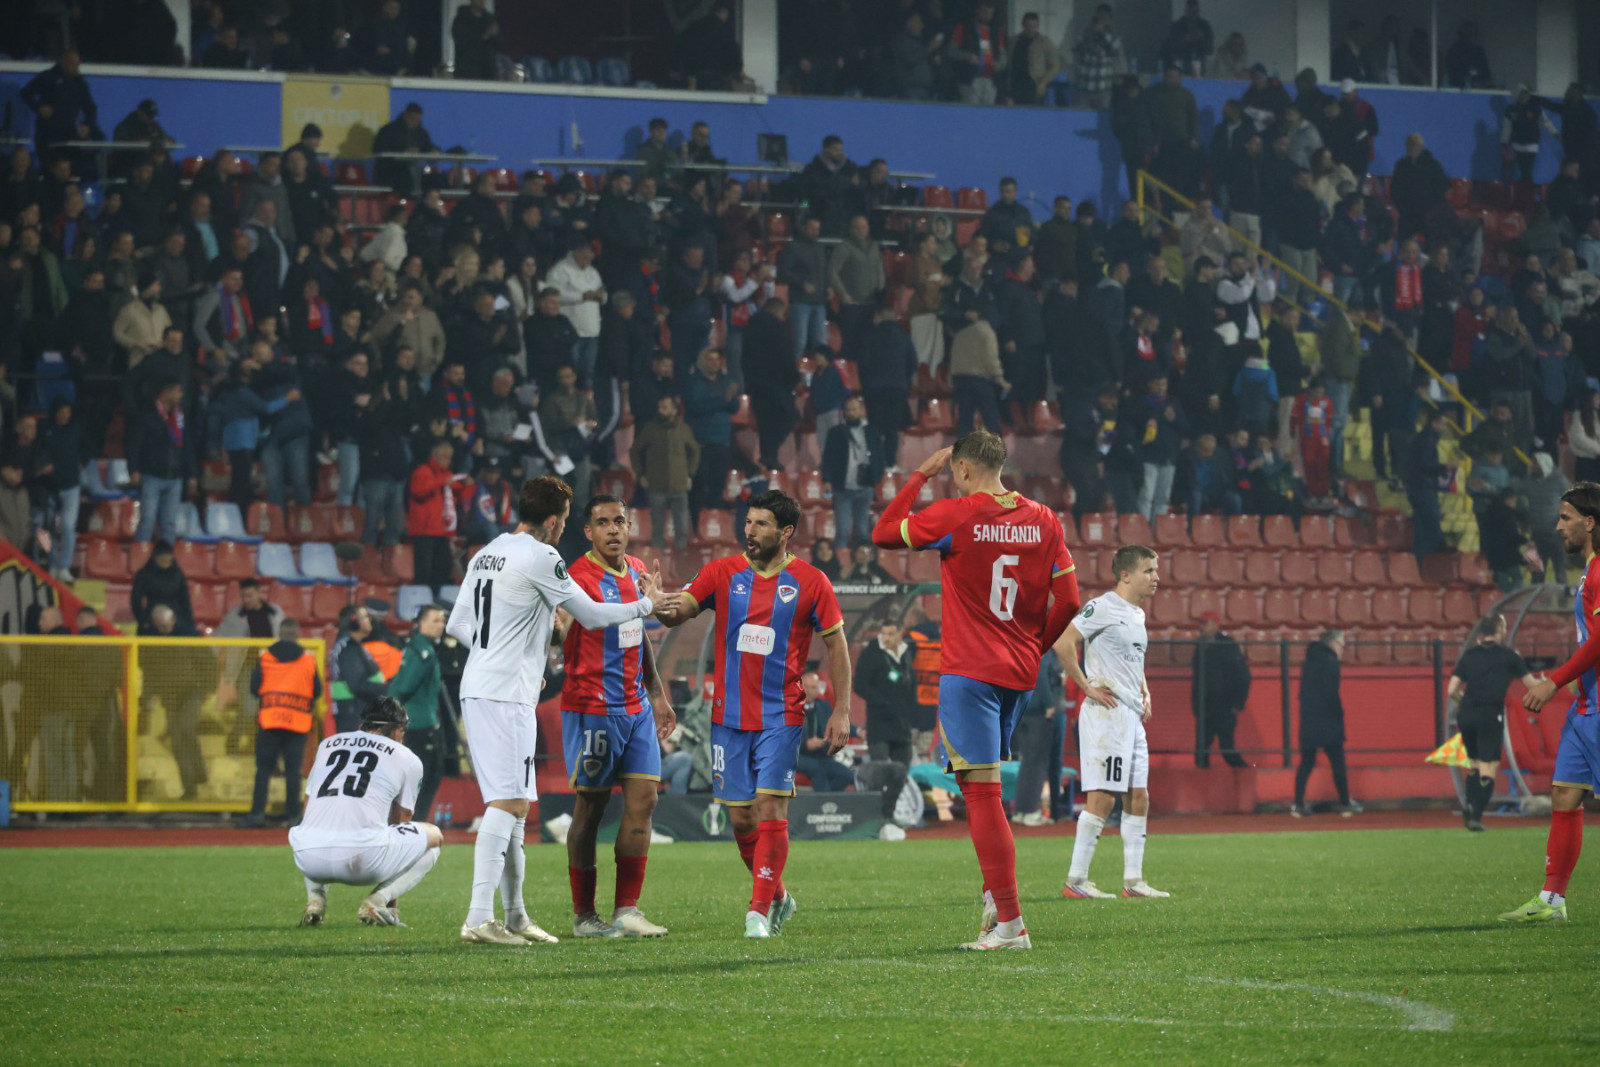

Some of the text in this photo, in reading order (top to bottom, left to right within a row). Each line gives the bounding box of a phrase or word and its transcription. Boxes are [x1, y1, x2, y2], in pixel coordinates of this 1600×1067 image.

[973, 521, 1042, 543] SANIČANIN
[989, 554, 1020, 622] 6
[472, 578, 494, 650] 11
[741, 634, 770, 646] m:tel
[583, 729, 608, 757] 16
[712, 744, 726, 772] 18
[1105, 755, 1123, 783] 16
[316, 749, 379, 799] 23
